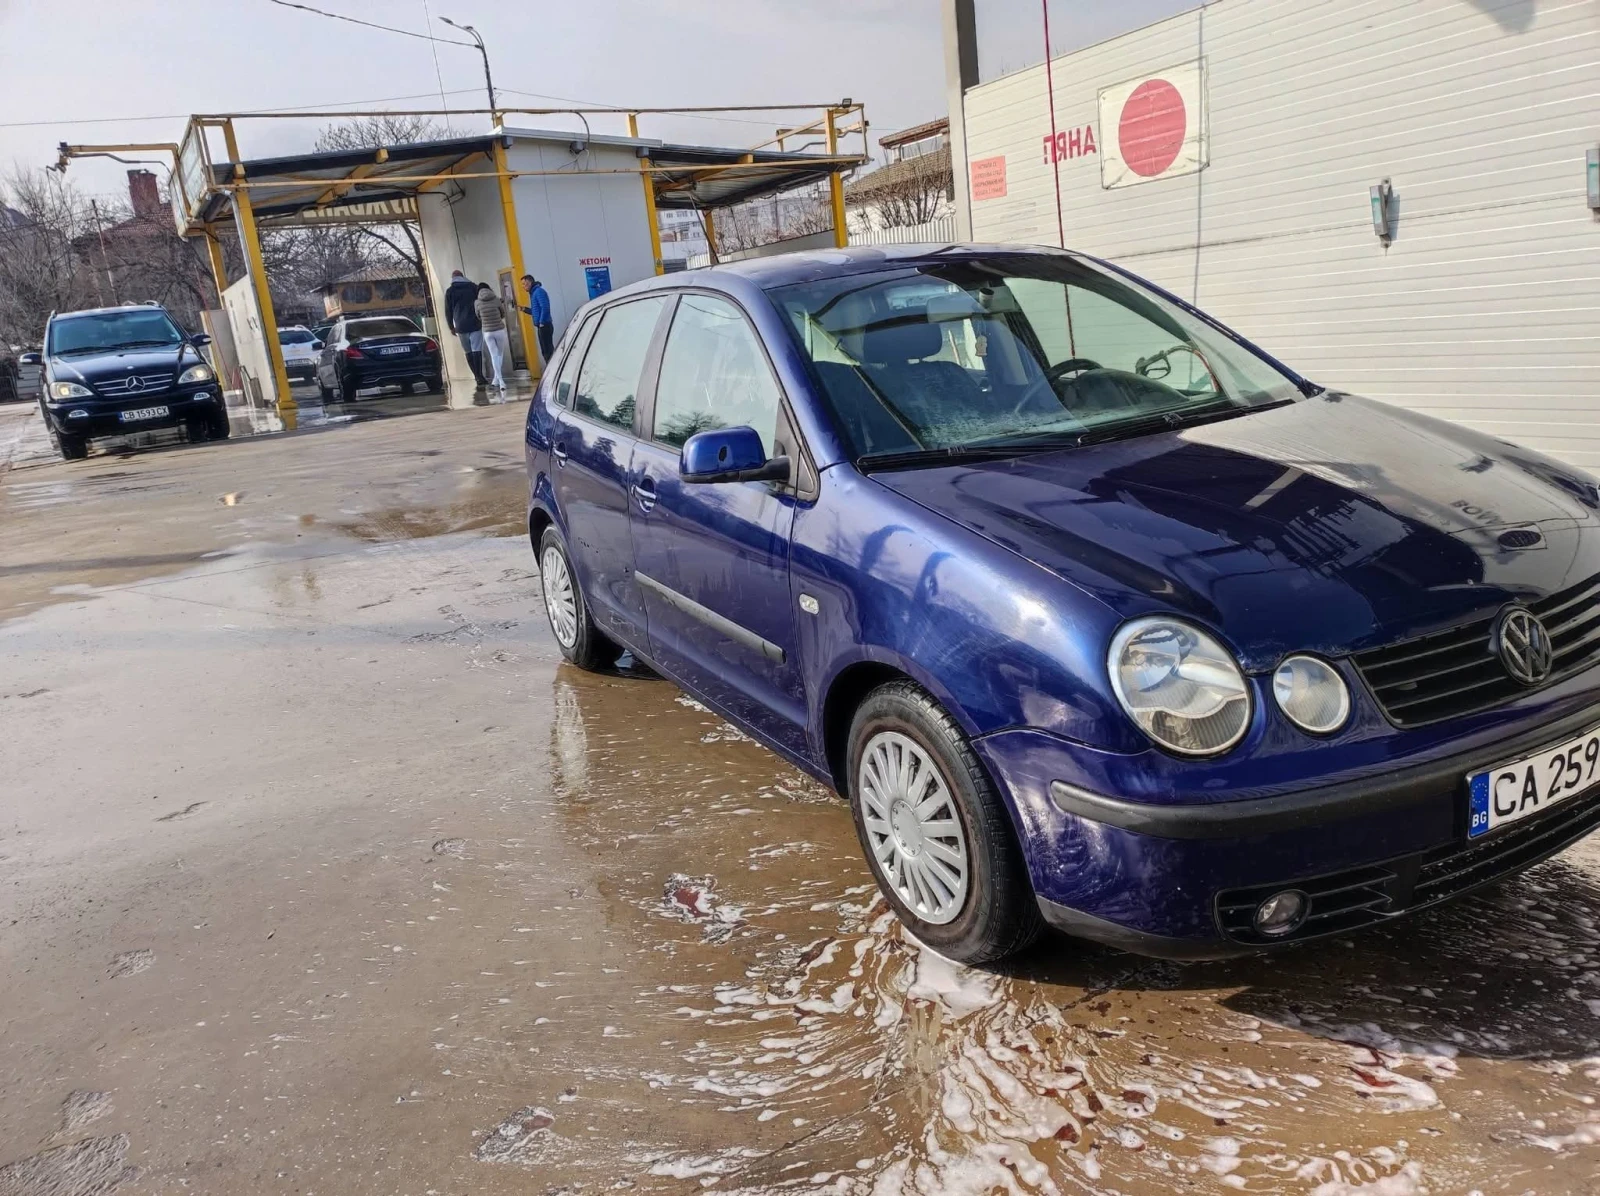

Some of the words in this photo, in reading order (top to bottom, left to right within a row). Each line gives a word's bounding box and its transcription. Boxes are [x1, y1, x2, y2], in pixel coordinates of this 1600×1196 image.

[1043, 125, 1097, 165] ПЯНА
[579, 257, 611, 266] ЖЕТОНИ
[123, 411, 135, 420] CB
[137, 409, 156, 418] 1593
[1494, 765, 1539, 817] CA
[1547, 737, 1600, 800] 259
[1472, 811, 1487, 827] BG
